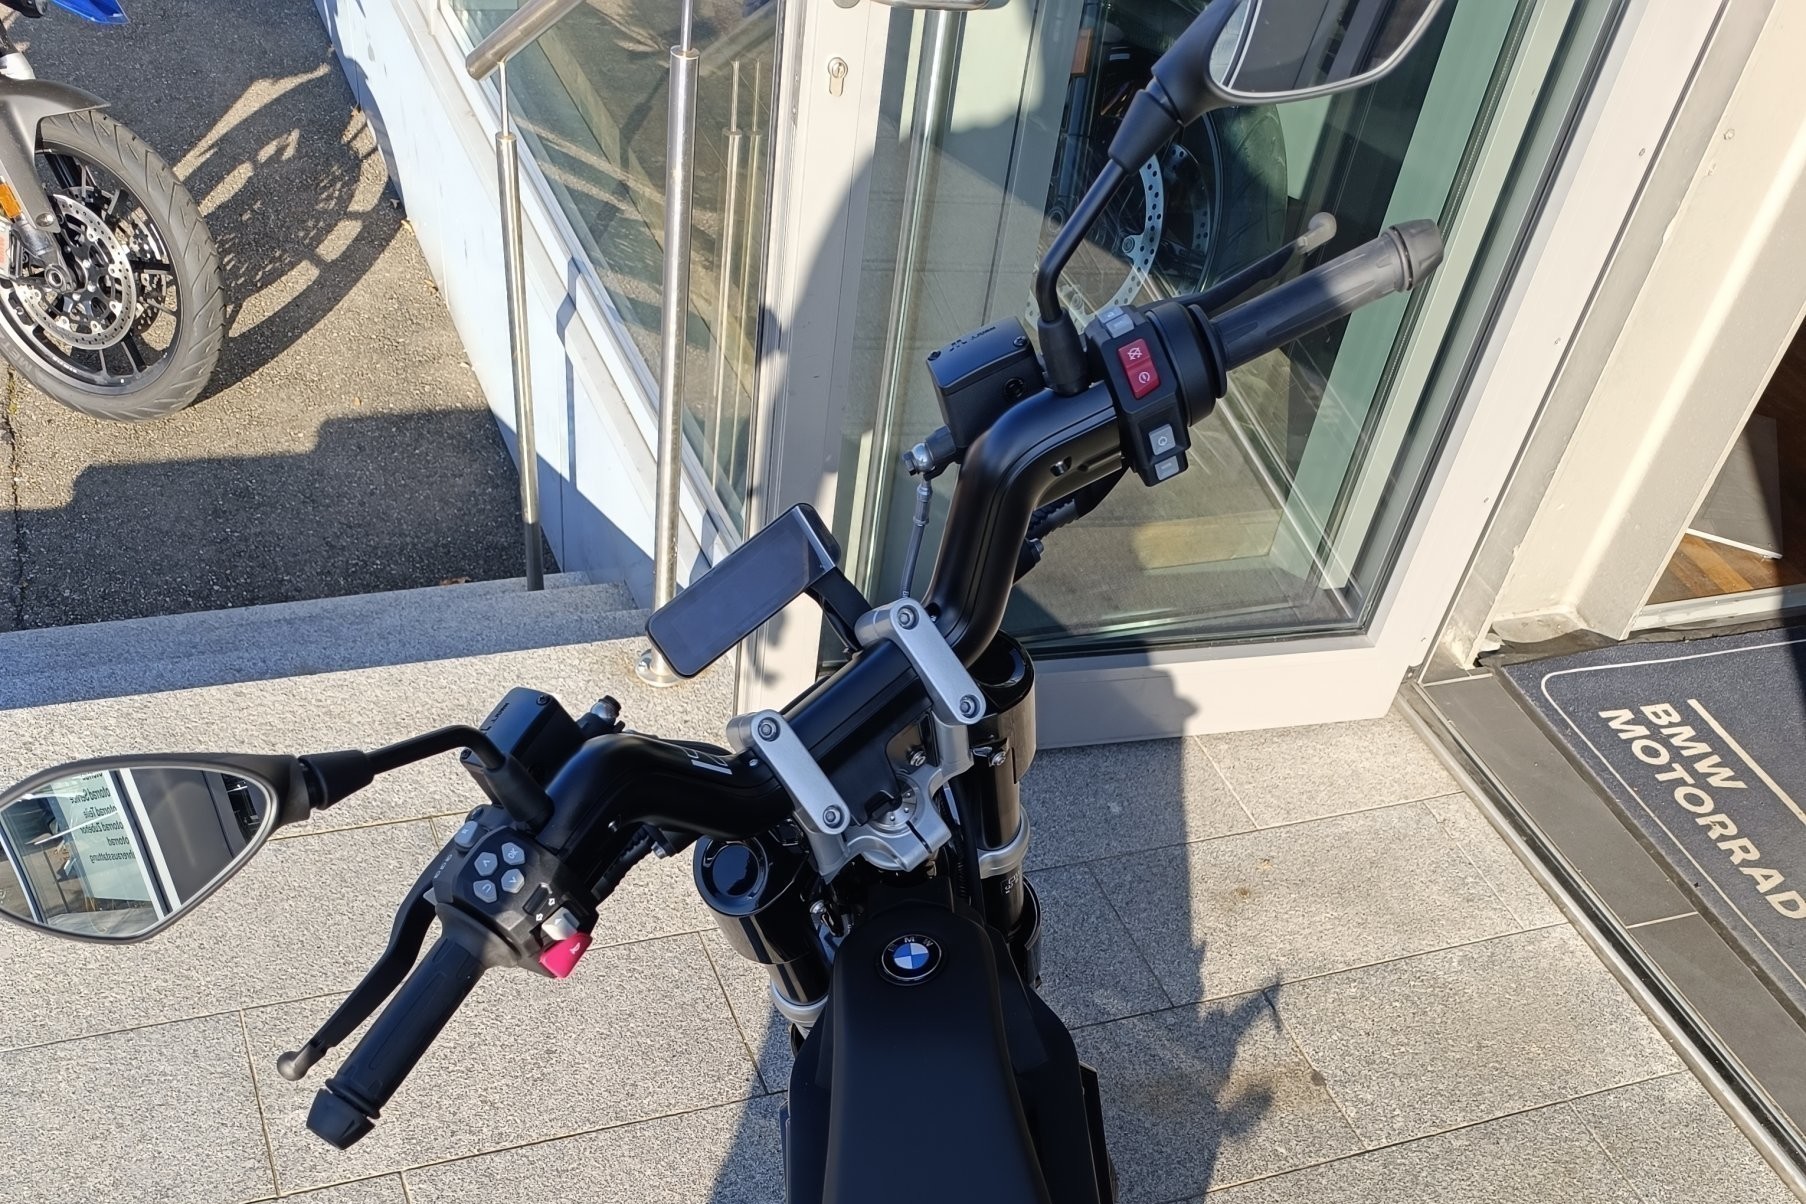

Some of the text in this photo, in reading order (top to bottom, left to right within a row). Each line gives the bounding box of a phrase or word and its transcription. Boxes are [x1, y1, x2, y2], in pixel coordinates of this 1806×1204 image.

[1639, 703, 1749, 789] BMW
[1598, 708, 1806, 920] MOTORRAD
[887, 936, 934, 952] BMW
